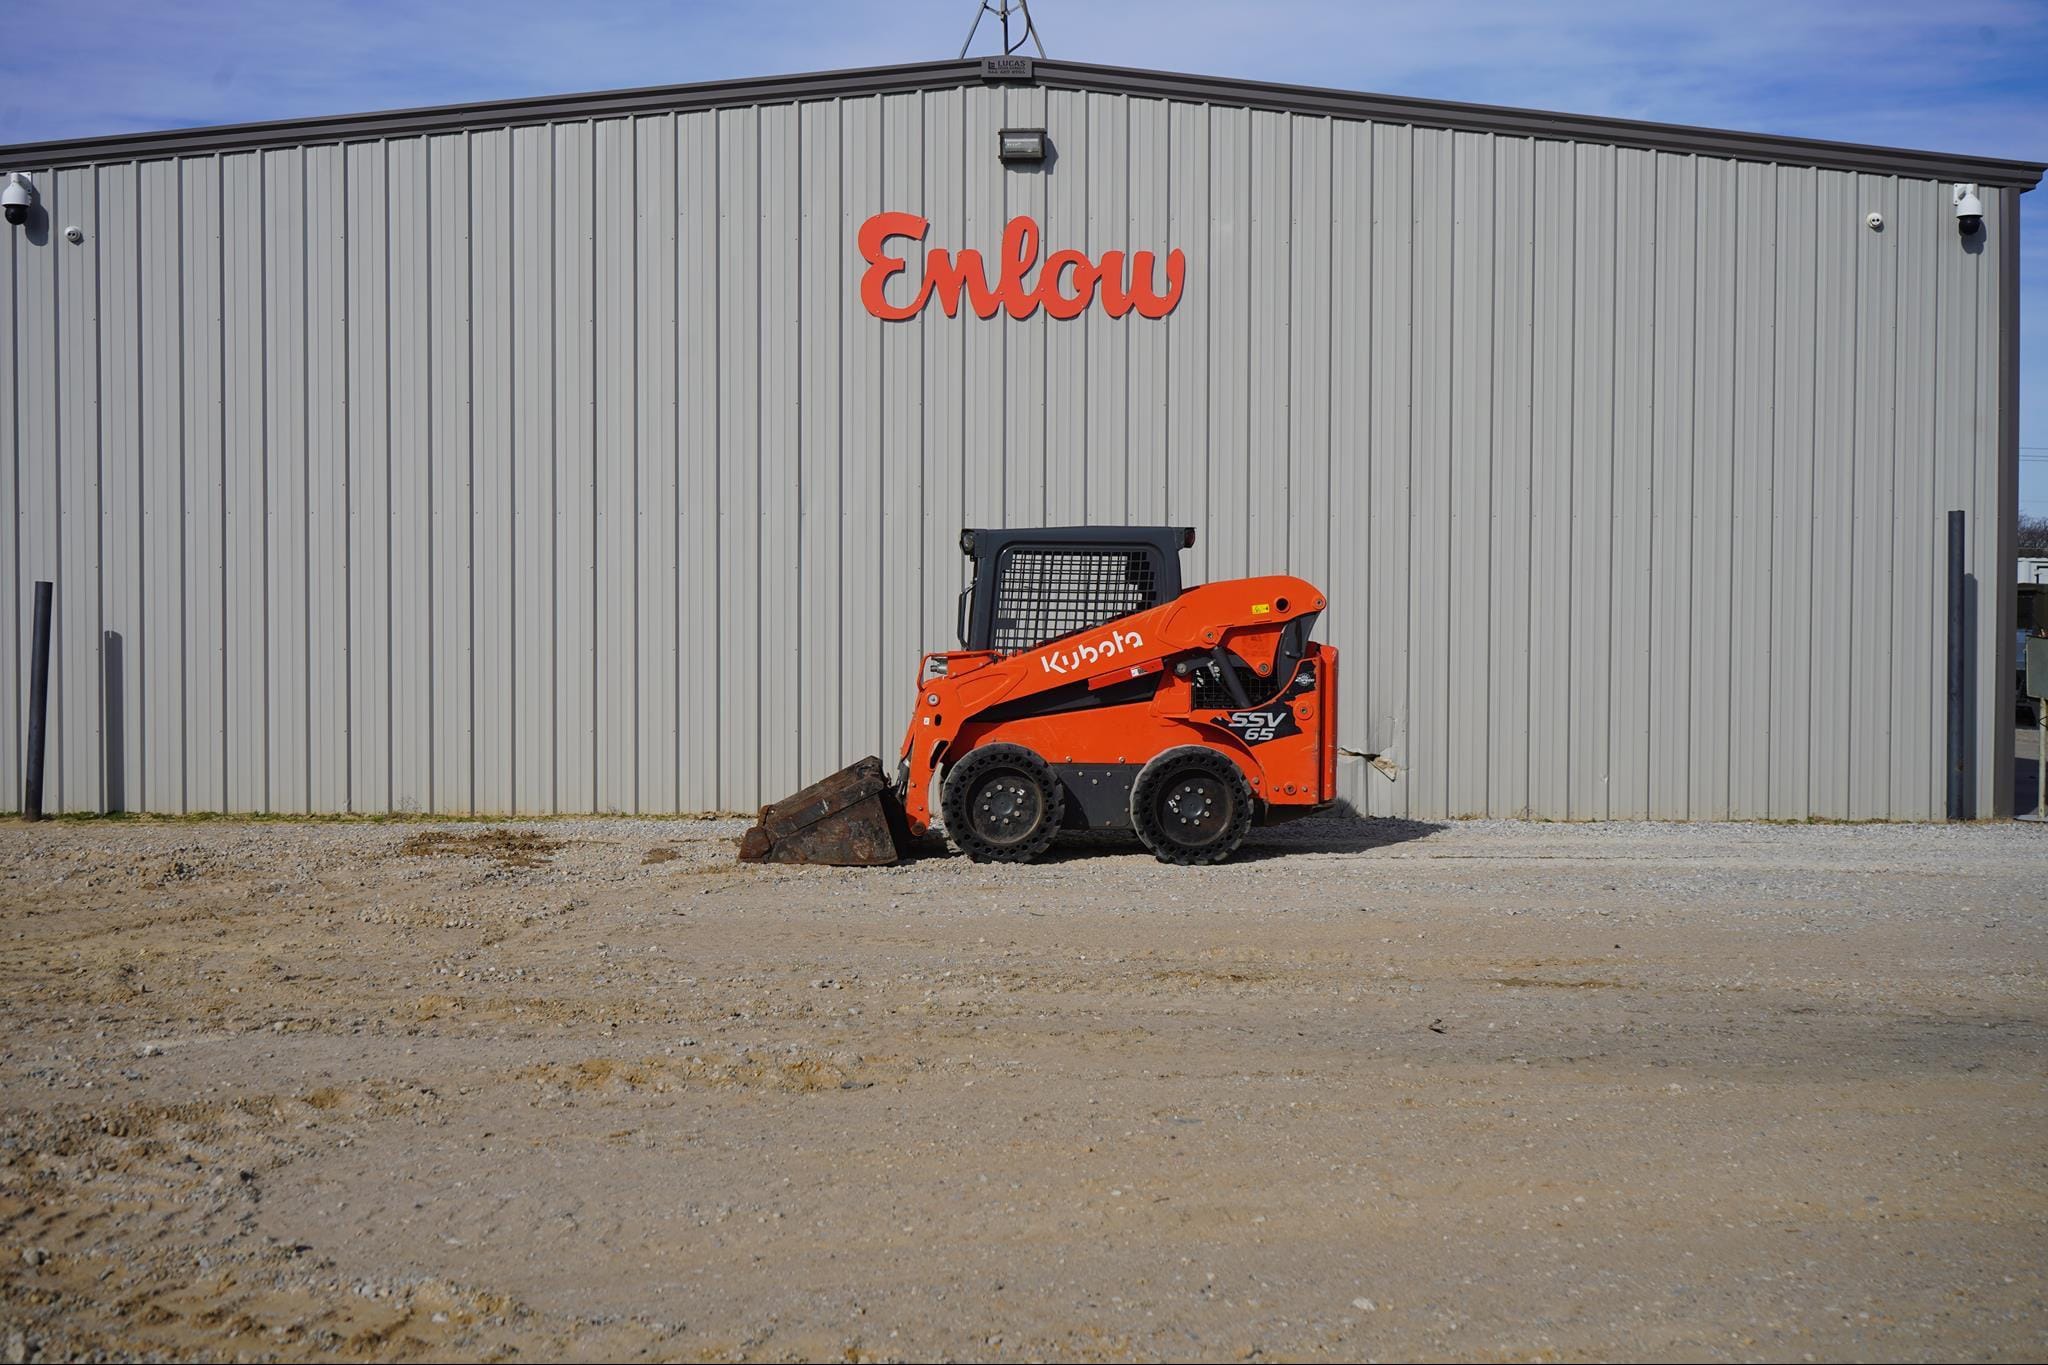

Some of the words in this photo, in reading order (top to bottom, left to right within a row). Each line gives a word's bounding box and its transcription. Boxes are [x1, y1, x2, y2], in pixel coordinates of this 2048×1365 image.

[857, 211, 1185, 320] Enlow
[1040, 630, 1144, 674] Kubota
[1228, 712, 1287, 728] SSV
[1244, 728, 1275, 741] 65
